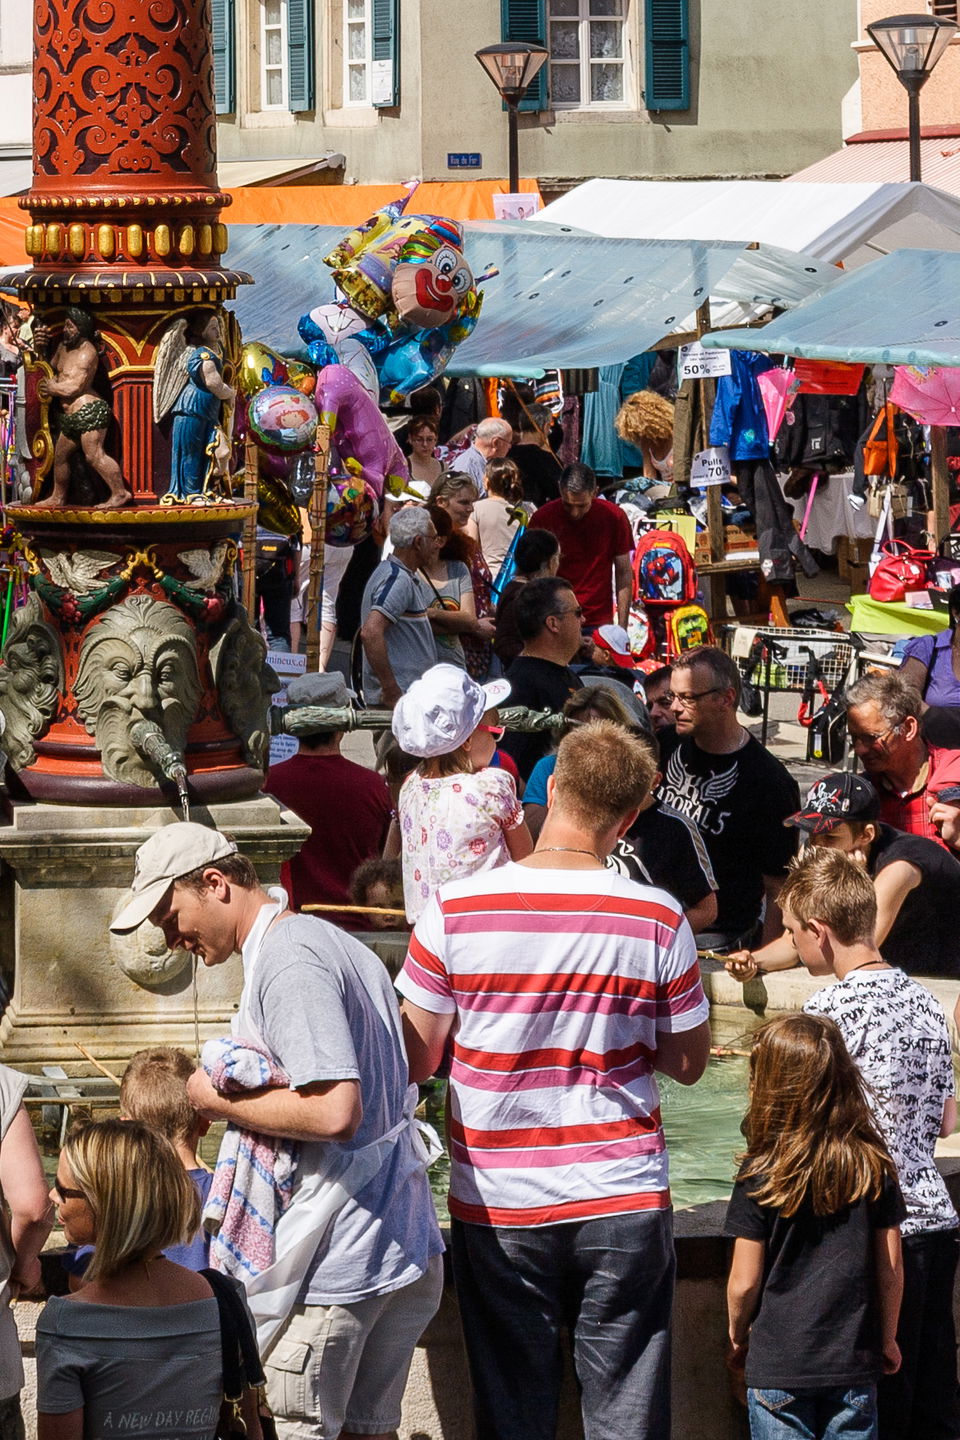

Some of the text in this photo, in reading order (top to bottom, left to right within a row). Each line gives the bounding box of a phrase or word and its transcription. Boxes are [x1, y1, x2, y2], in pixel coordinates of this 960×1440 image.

[684, 363, 711, 375] 50%
[701, 458, 723, 467] Pulls
[708, 465, 730, 478] 70%
[656, 785, 732, 835] APORAL 5
[103, 1411, 114, 1428] A
[117, 1411, 153, 1430] NEW
[155, 1410, 184, 1428] DAY
